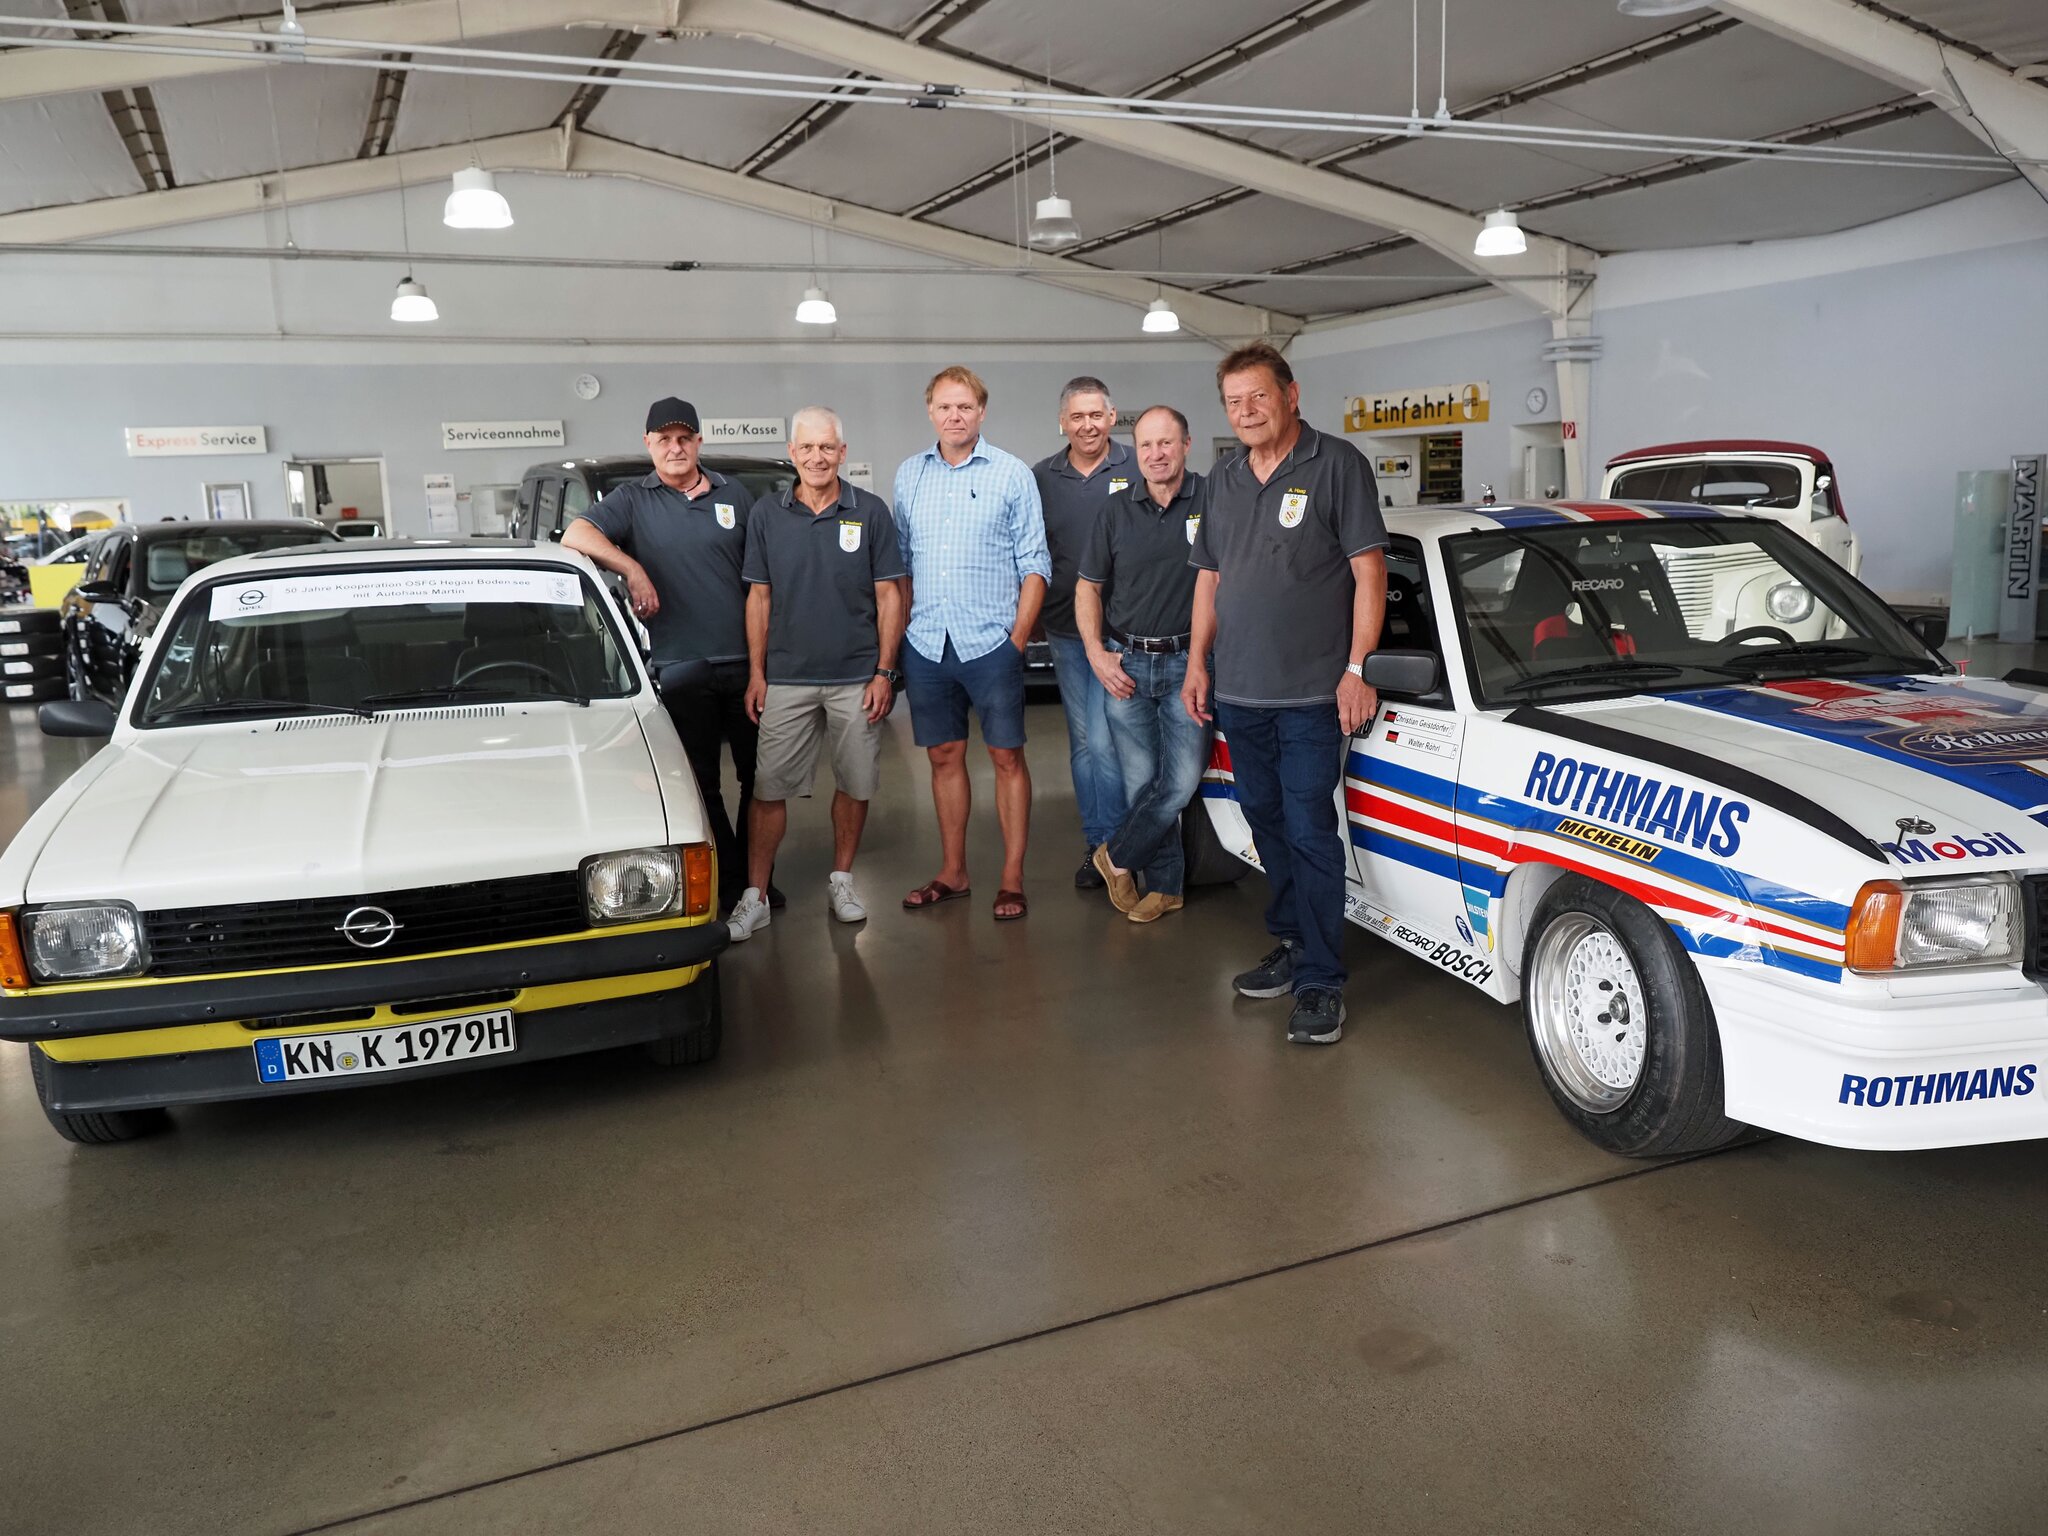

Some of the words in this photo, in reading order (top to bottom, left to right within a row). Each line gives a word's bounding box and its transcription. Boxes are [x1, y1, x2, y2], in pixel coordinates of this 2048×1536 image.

[1374, 392, 1454, 423] Einfahrt
[136, 433, 197, 449] Express
[200, 432, 257, 446] Service
[448, 425, 561, 441] Serviceannahme
[712, 423, 778, 436] Info/Kasse
[2008, 460, 2037, 600] MARTIN
[302, 585, 332, 594] Jahre
[336, 581, 402, 592] Kooperation
[440, 579, 474, 588] Hegau
[376, 589, 428, 598] Autohaus
[431, 588, 465, 596] Martin
[1571, 578, 1625, 592] RECARO
[1396, 714, 1419, 726] Christian
[1408, 738, 1425, 749] Walter
[1919, 731, 2048, 750] Rothm
[1524, 751, 1750, 858] ROTHMANS
[1557, 819, 1660, 860] MICHELIN
[1881, 831, 2026, 865] Mobil
[1393, 925, 1436, 952] RECARO
[1429, 942, 1494, 985] BOSCH
[268, 1064, 278, 1074] D
[283, 1040, 335, 1076] KN
[361, 1034, 387, 1068] K
[395, 1015, 511, 1064] 1979H
[1838, 1063, 2037, 1108] ROTHMANS
